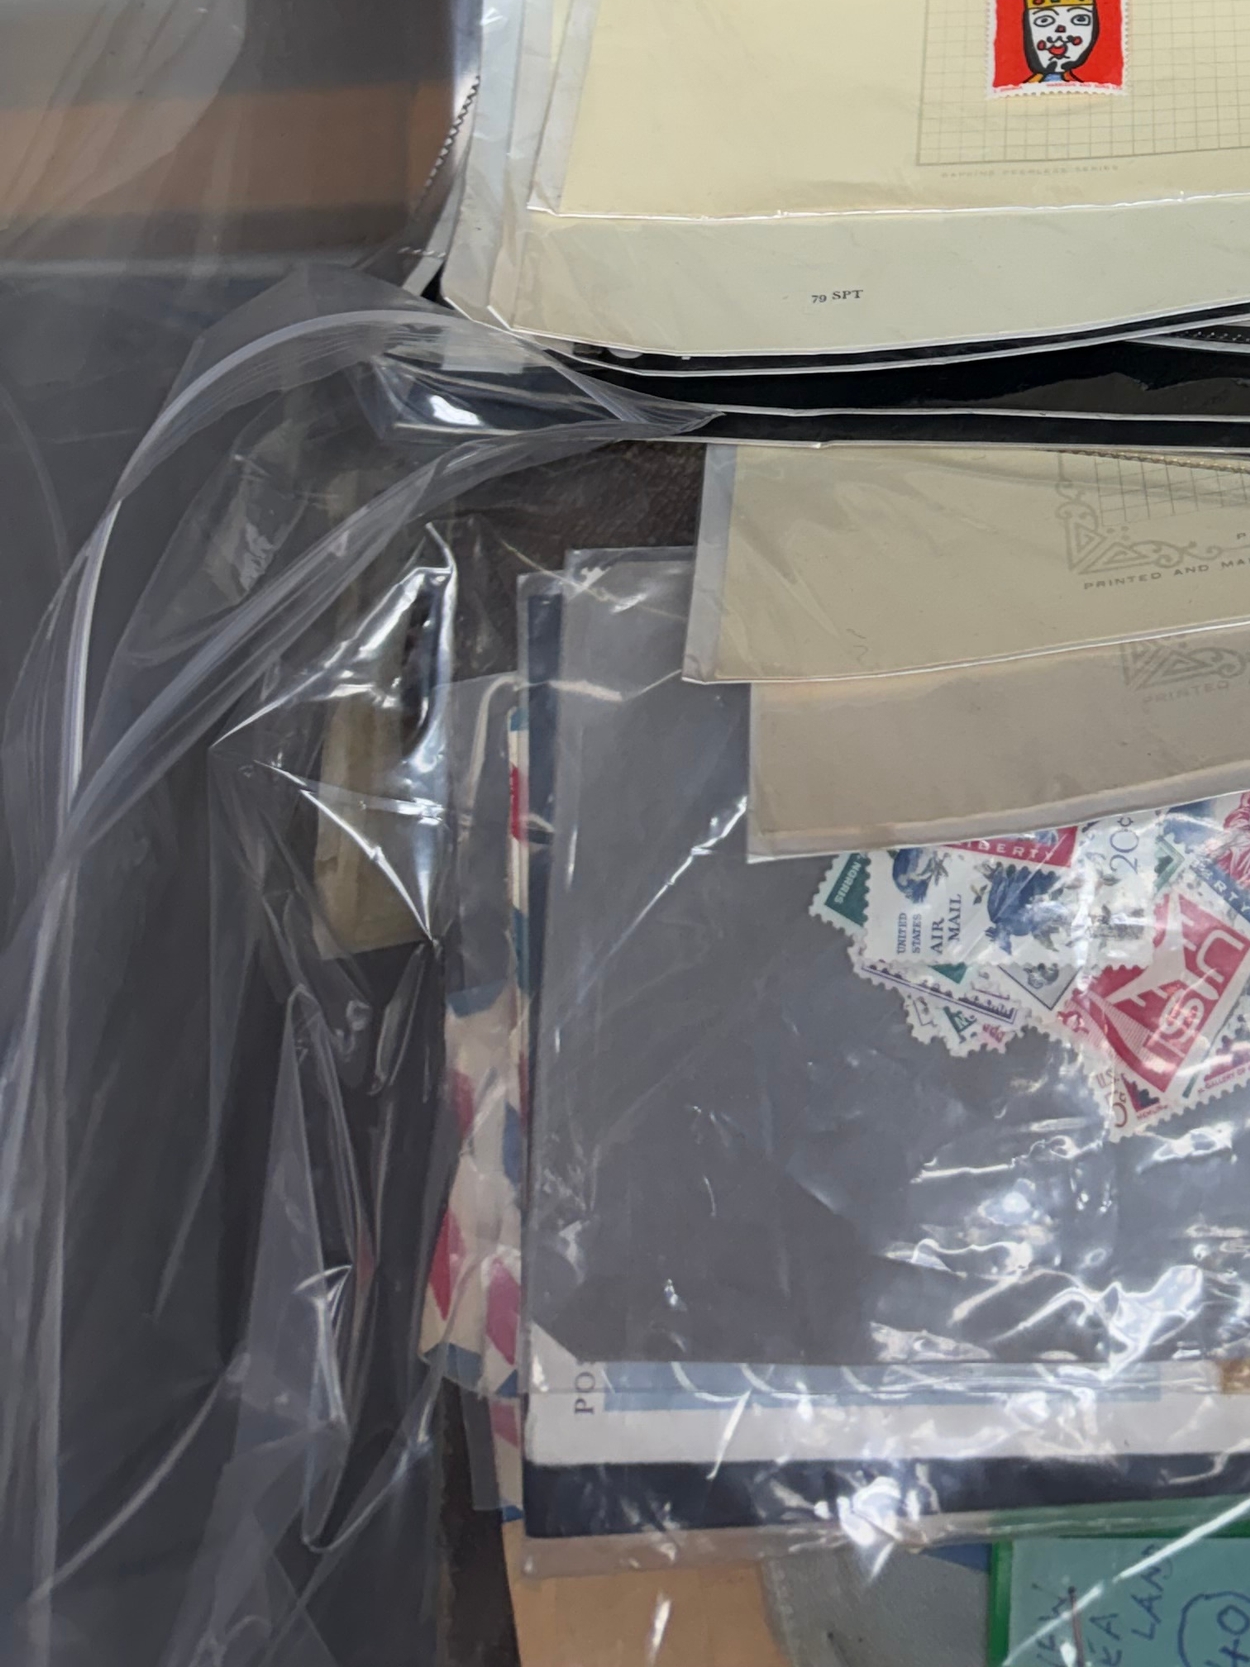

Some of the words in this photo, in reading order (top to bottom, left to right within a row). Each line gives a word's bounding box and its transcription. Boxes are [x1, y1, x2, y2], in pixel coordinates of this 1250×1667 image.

[810, 291, 828, 305] 79
[831, 288, 864, 303] SPT
[1083, 570, 1163, 592] PRINTED
[1173, 563, 1211, 578] AND
[834, 860, 863, 905] NORRIS
[896, 912, 909, 955] UNITED
[911, 913, 923, 954] STATES
[930, 917, 945, 955] AIR
[947, 893, 963, 942] MAIL
